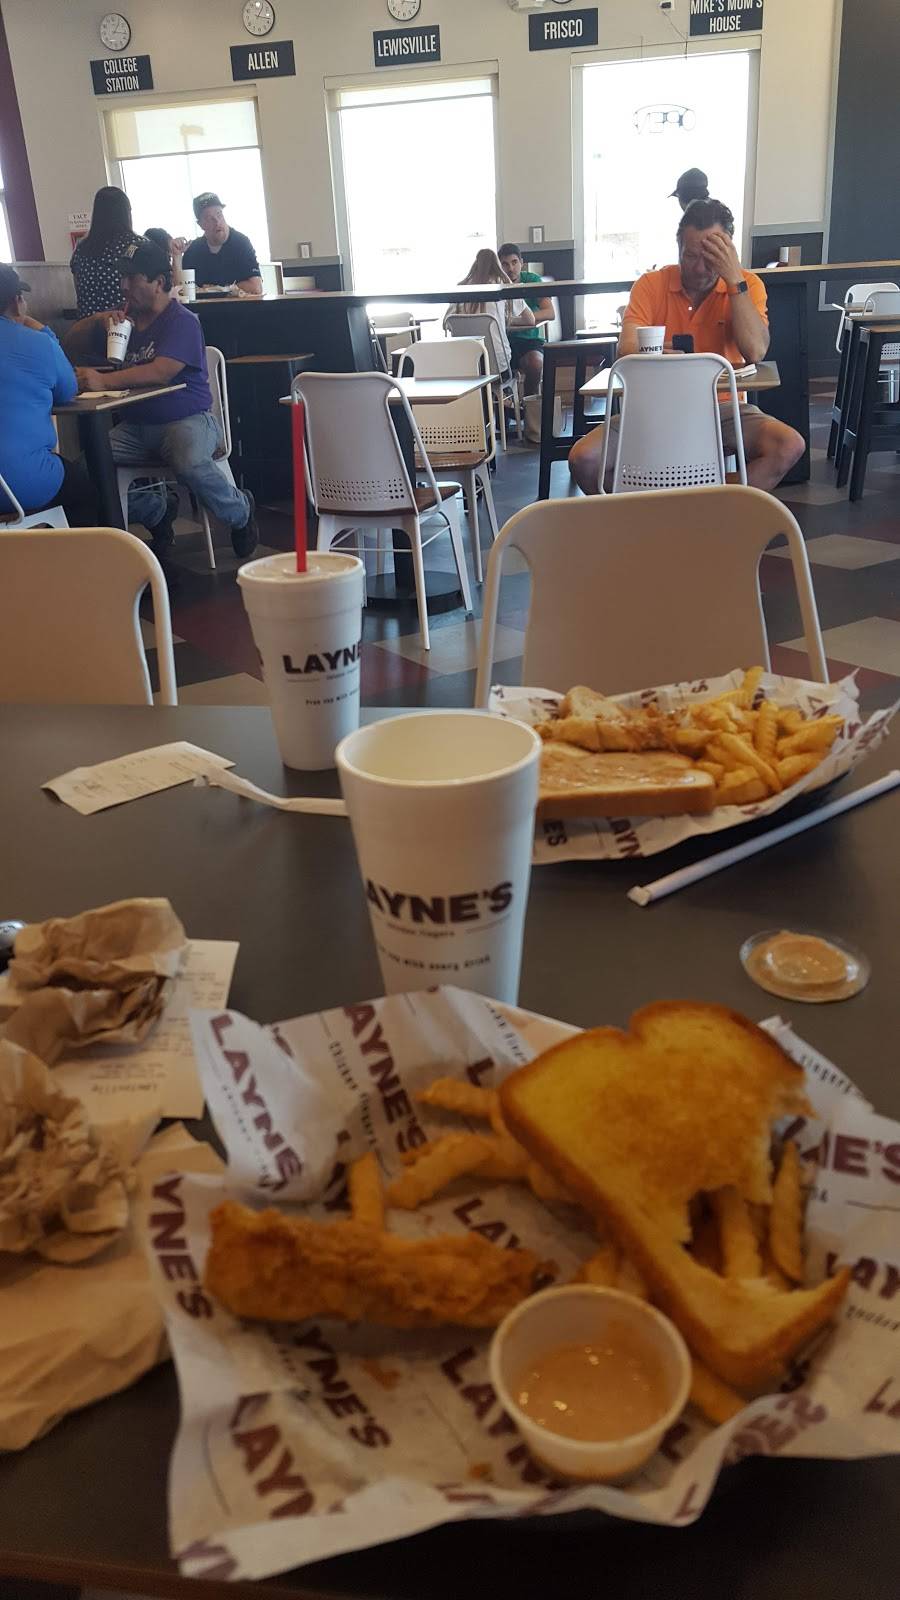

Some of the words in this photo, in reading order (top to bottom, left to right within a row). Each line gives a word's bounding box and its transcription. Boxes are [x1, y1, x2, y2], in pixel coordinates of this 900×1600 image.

[690, 0, 725, 15] MIKE'S
[727, 0, 763, 11] MOMS
[544, 18, 583, 41] FRISCO
[709, 15, 742, 33] HOUSE
[377, 34, 437, 57] LEWISVILLE
[103, 57, 138, 75] COLLEGE
[248, 51, 279, 71] ALLEN
[105, 76, 140, 92] STATION
